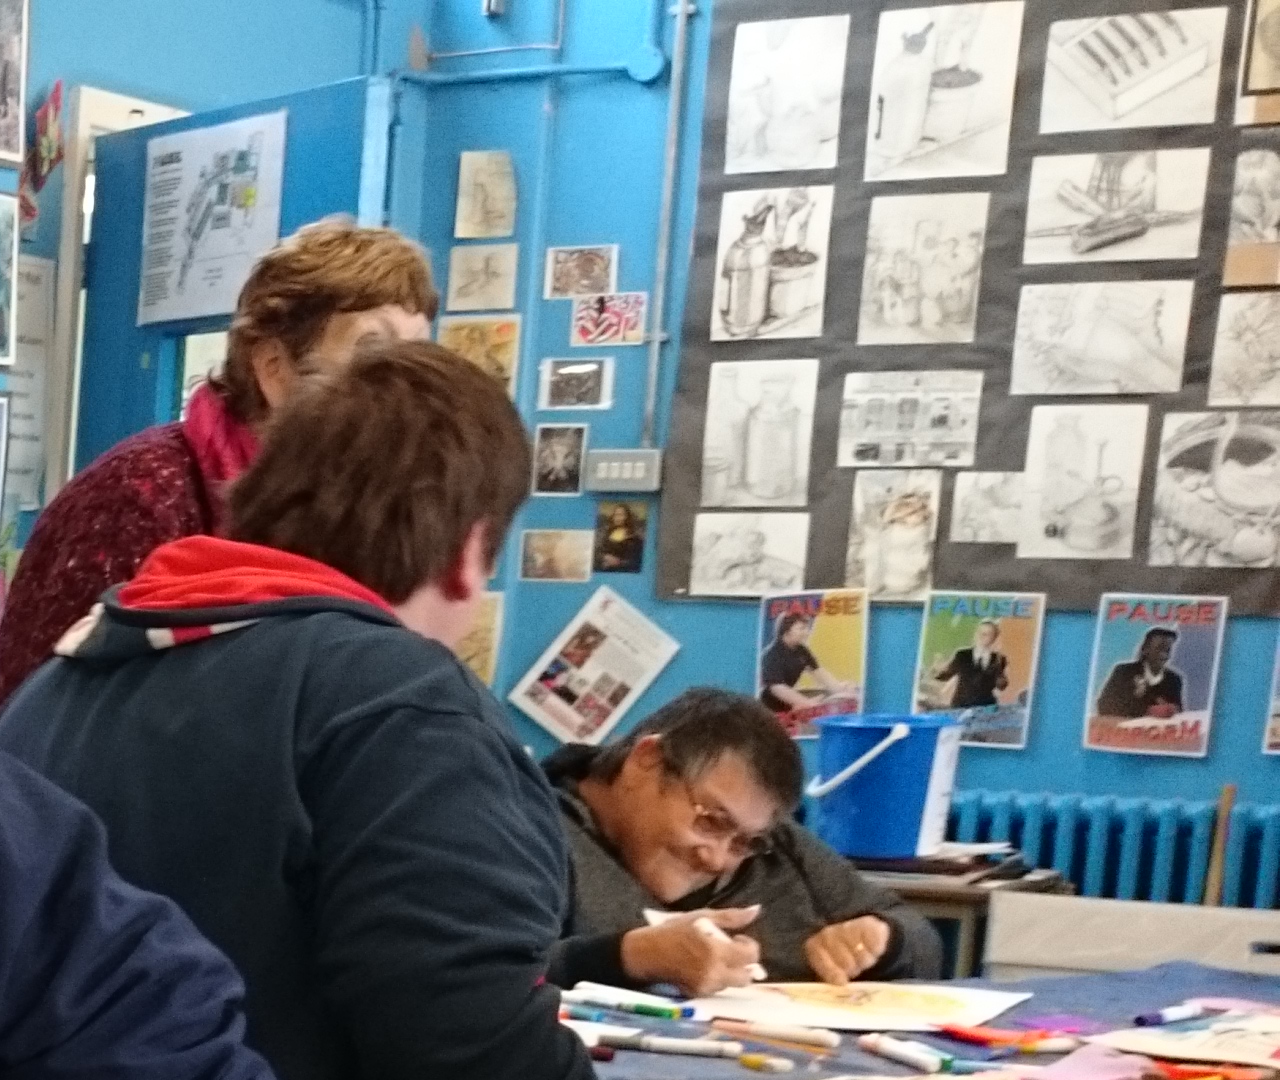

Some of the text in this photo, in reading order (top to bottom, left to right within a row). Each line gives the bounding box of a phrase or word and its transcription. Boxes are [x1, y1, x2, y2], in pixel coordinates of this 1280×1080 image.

[770, 597, 862, 616] PAUSE
[932, 597, 1032, 617] PAUSE
[1108, 602, 1217, 623] PAUSE
